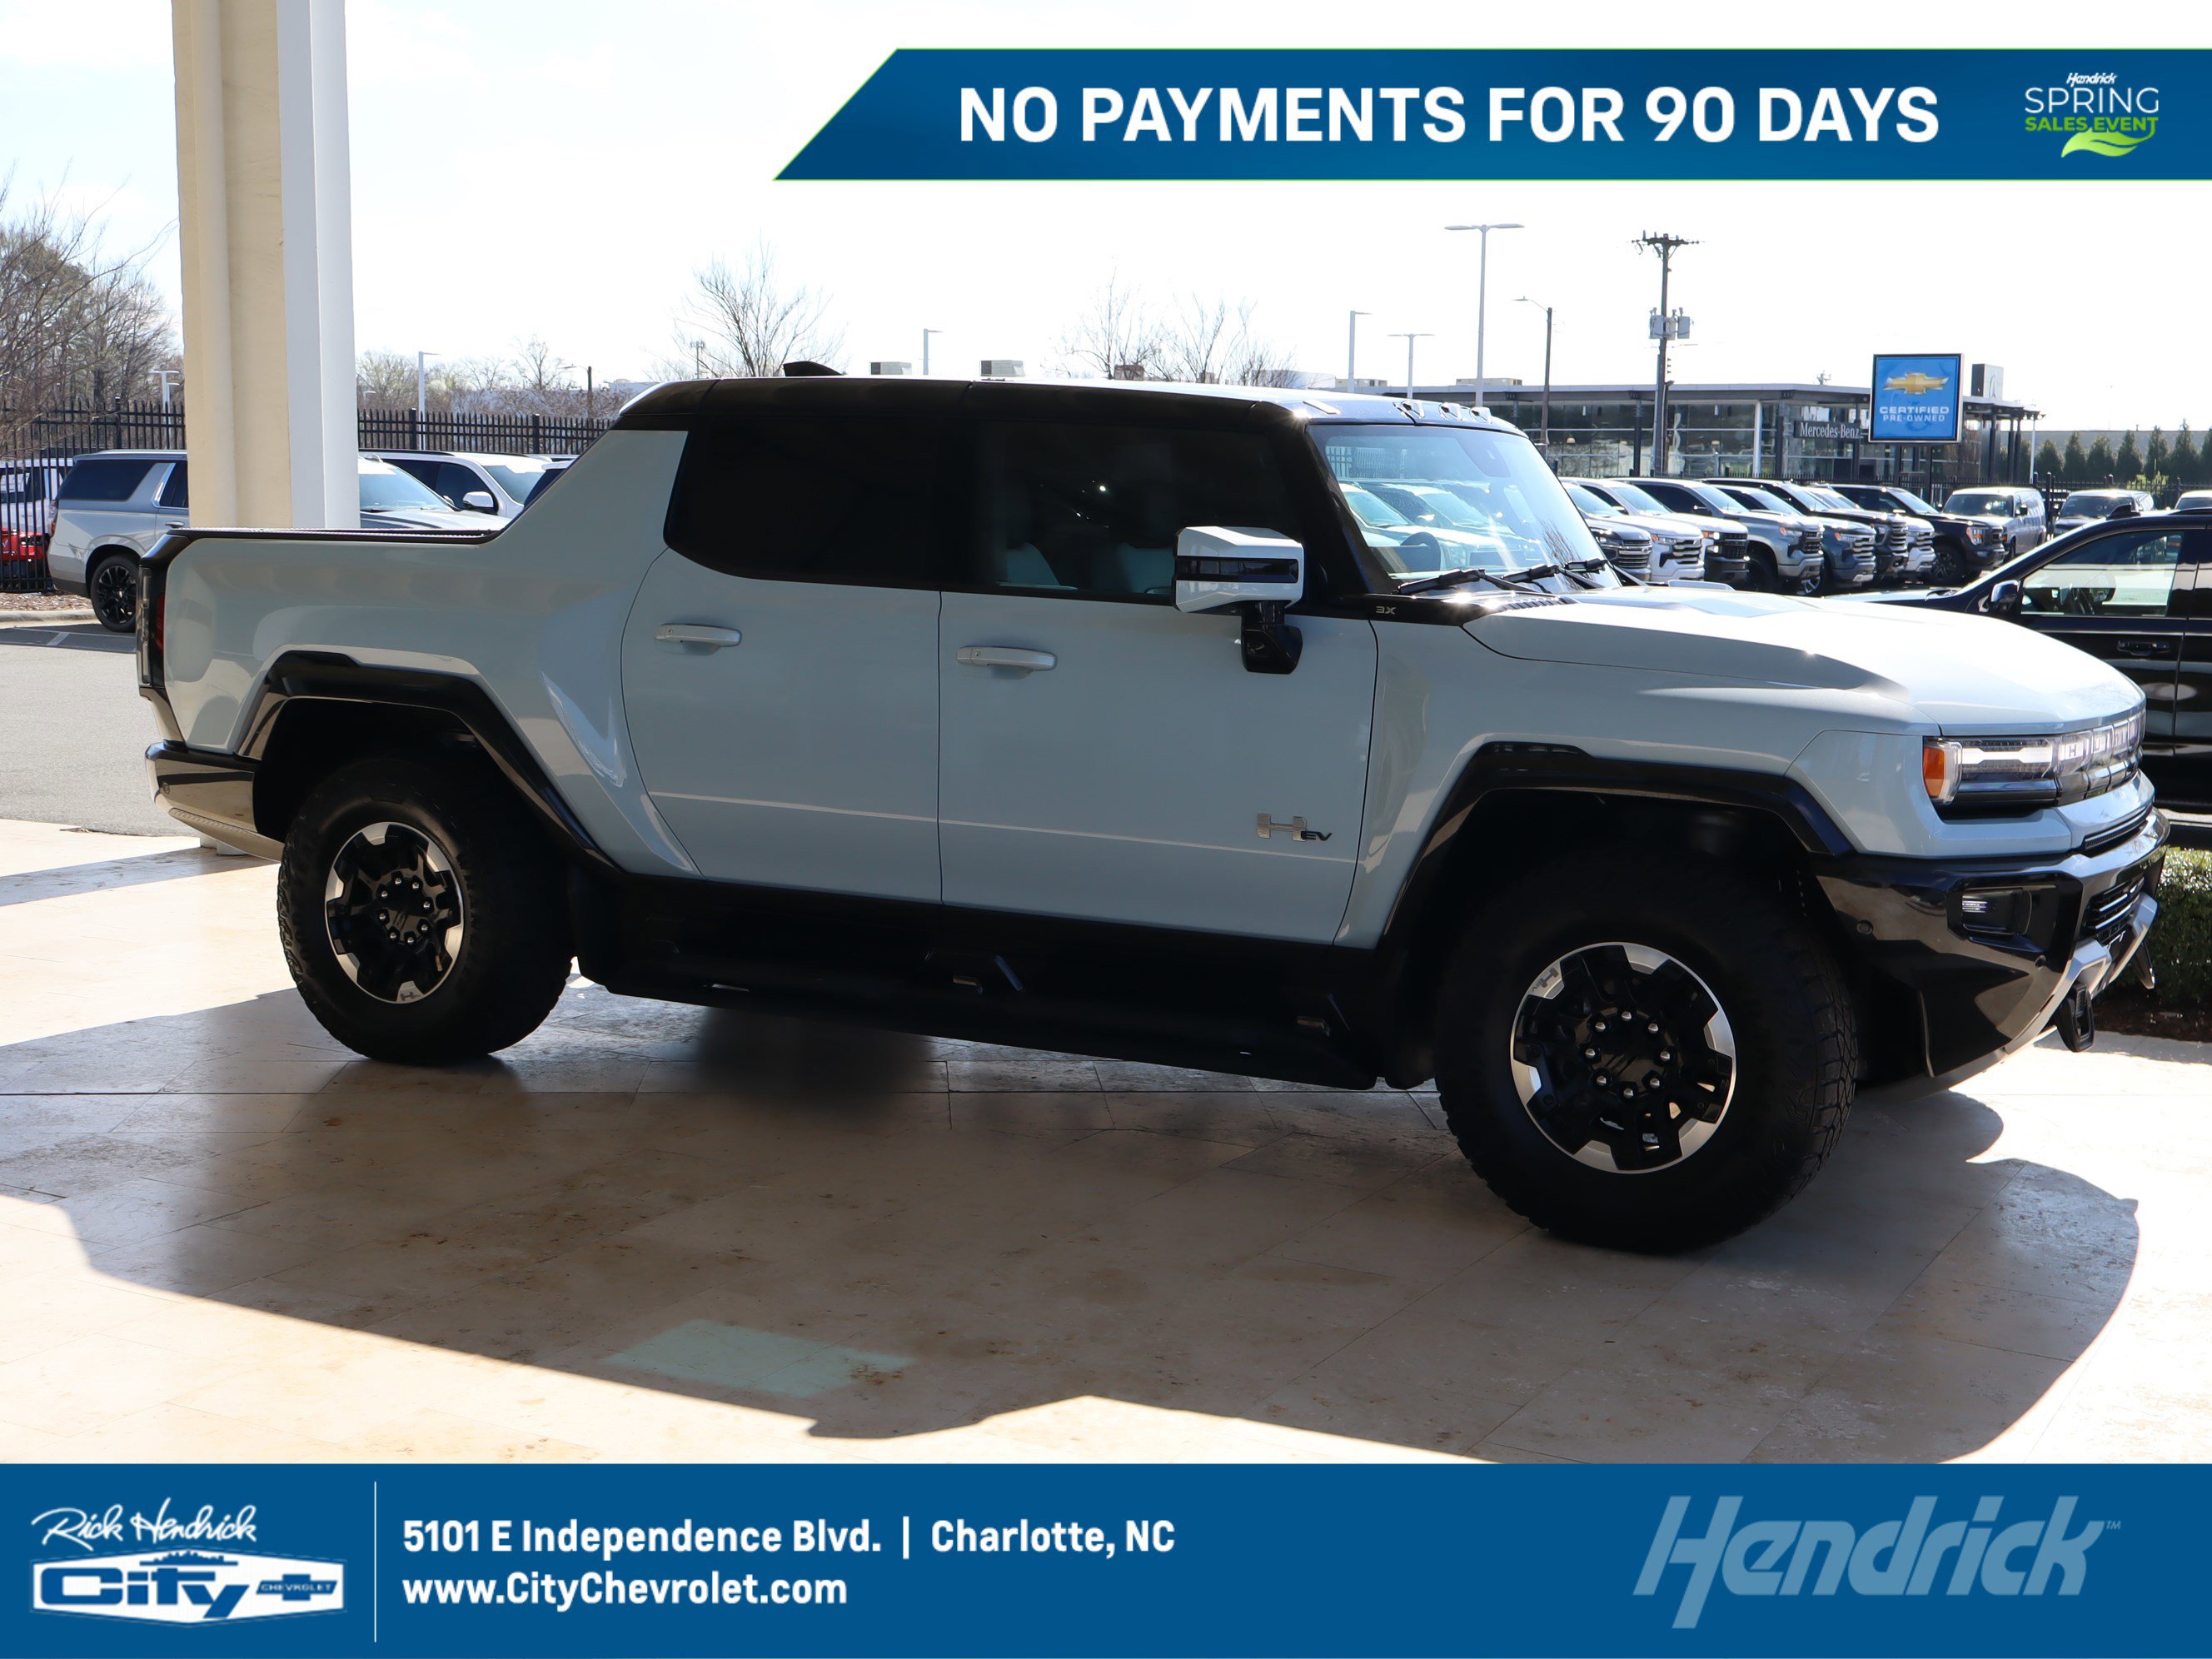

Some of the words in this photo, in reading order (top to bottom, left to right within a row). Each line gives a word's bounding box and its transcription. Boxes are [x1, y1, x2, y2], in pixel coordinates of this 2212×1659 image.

[1879, 406, 1950, 414] CERTIFIED
[1800, 421, 1860, 439] Mercedes-Benz
[1375, 605, 1397, 615] 3X
